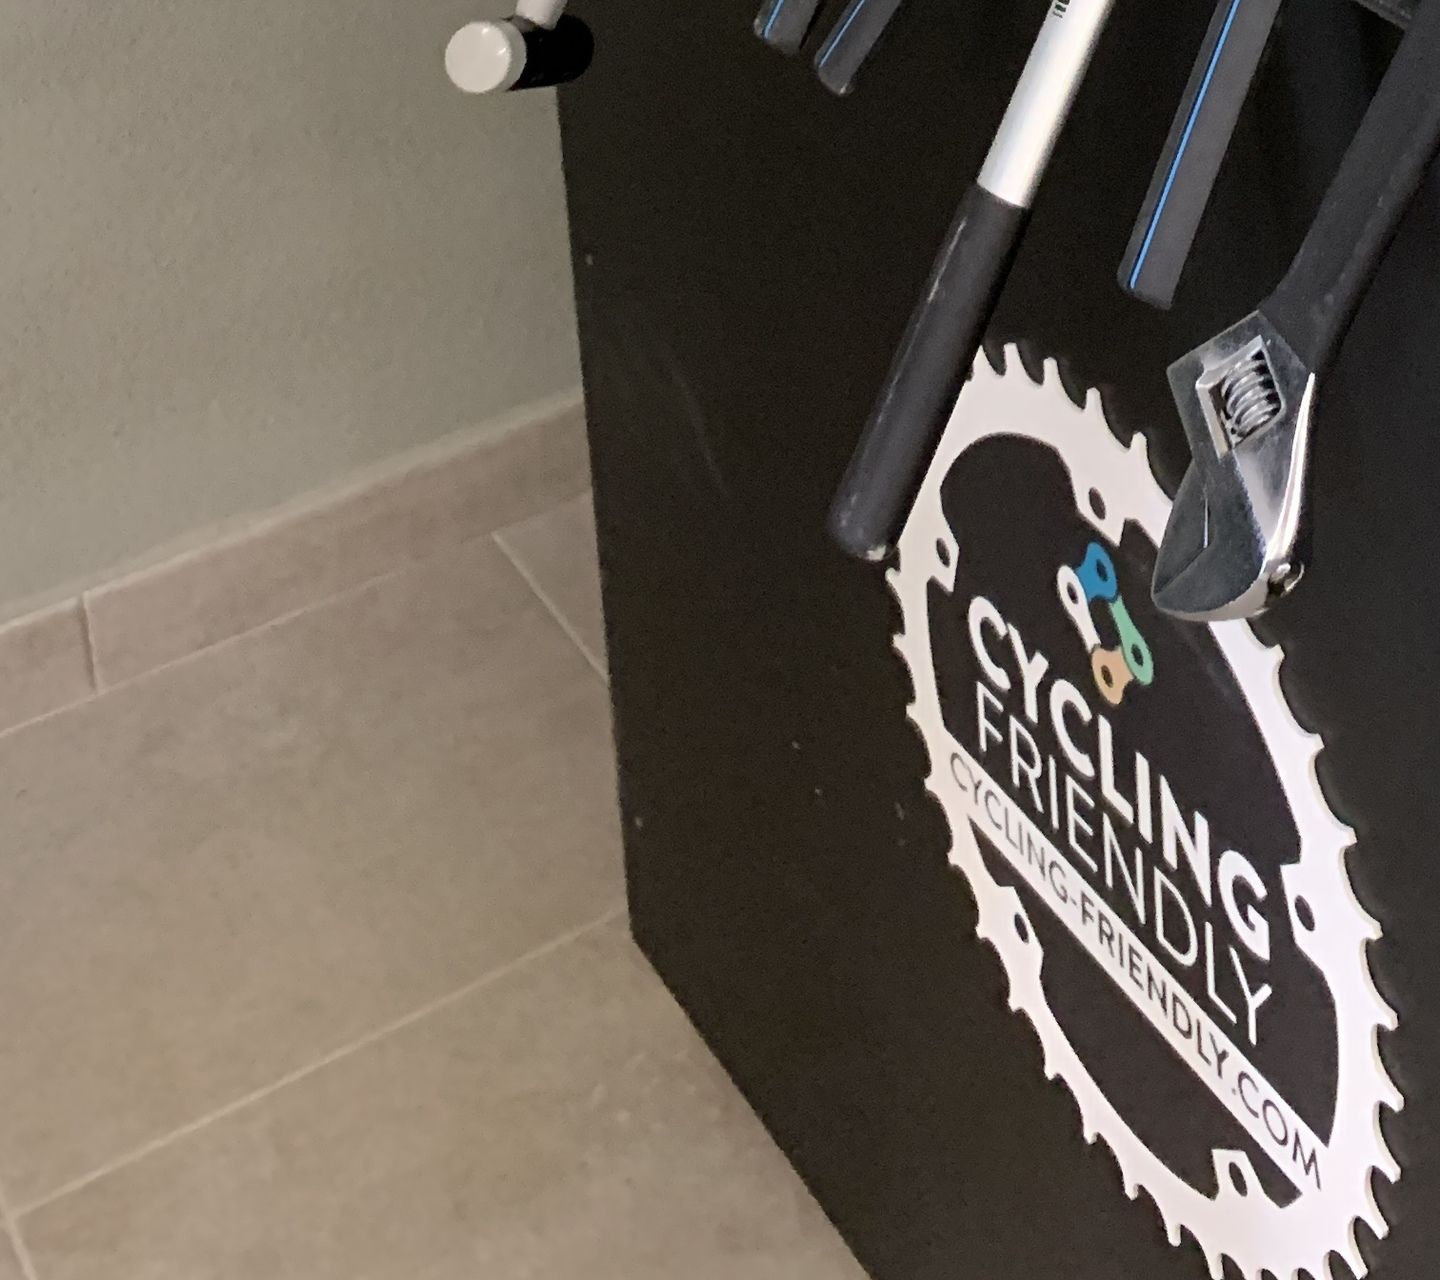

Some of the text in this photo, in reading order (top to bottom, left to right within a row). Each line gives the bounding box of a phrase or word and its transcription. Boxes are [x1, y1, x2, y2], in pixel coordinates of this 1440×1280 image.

[967, 595, 1271, 961] CYCLING
[976, 680, 1273, 1046] FRIENDLY
[949, 751, 1322, 1191] CYCLING-FRIENDLY.COM
